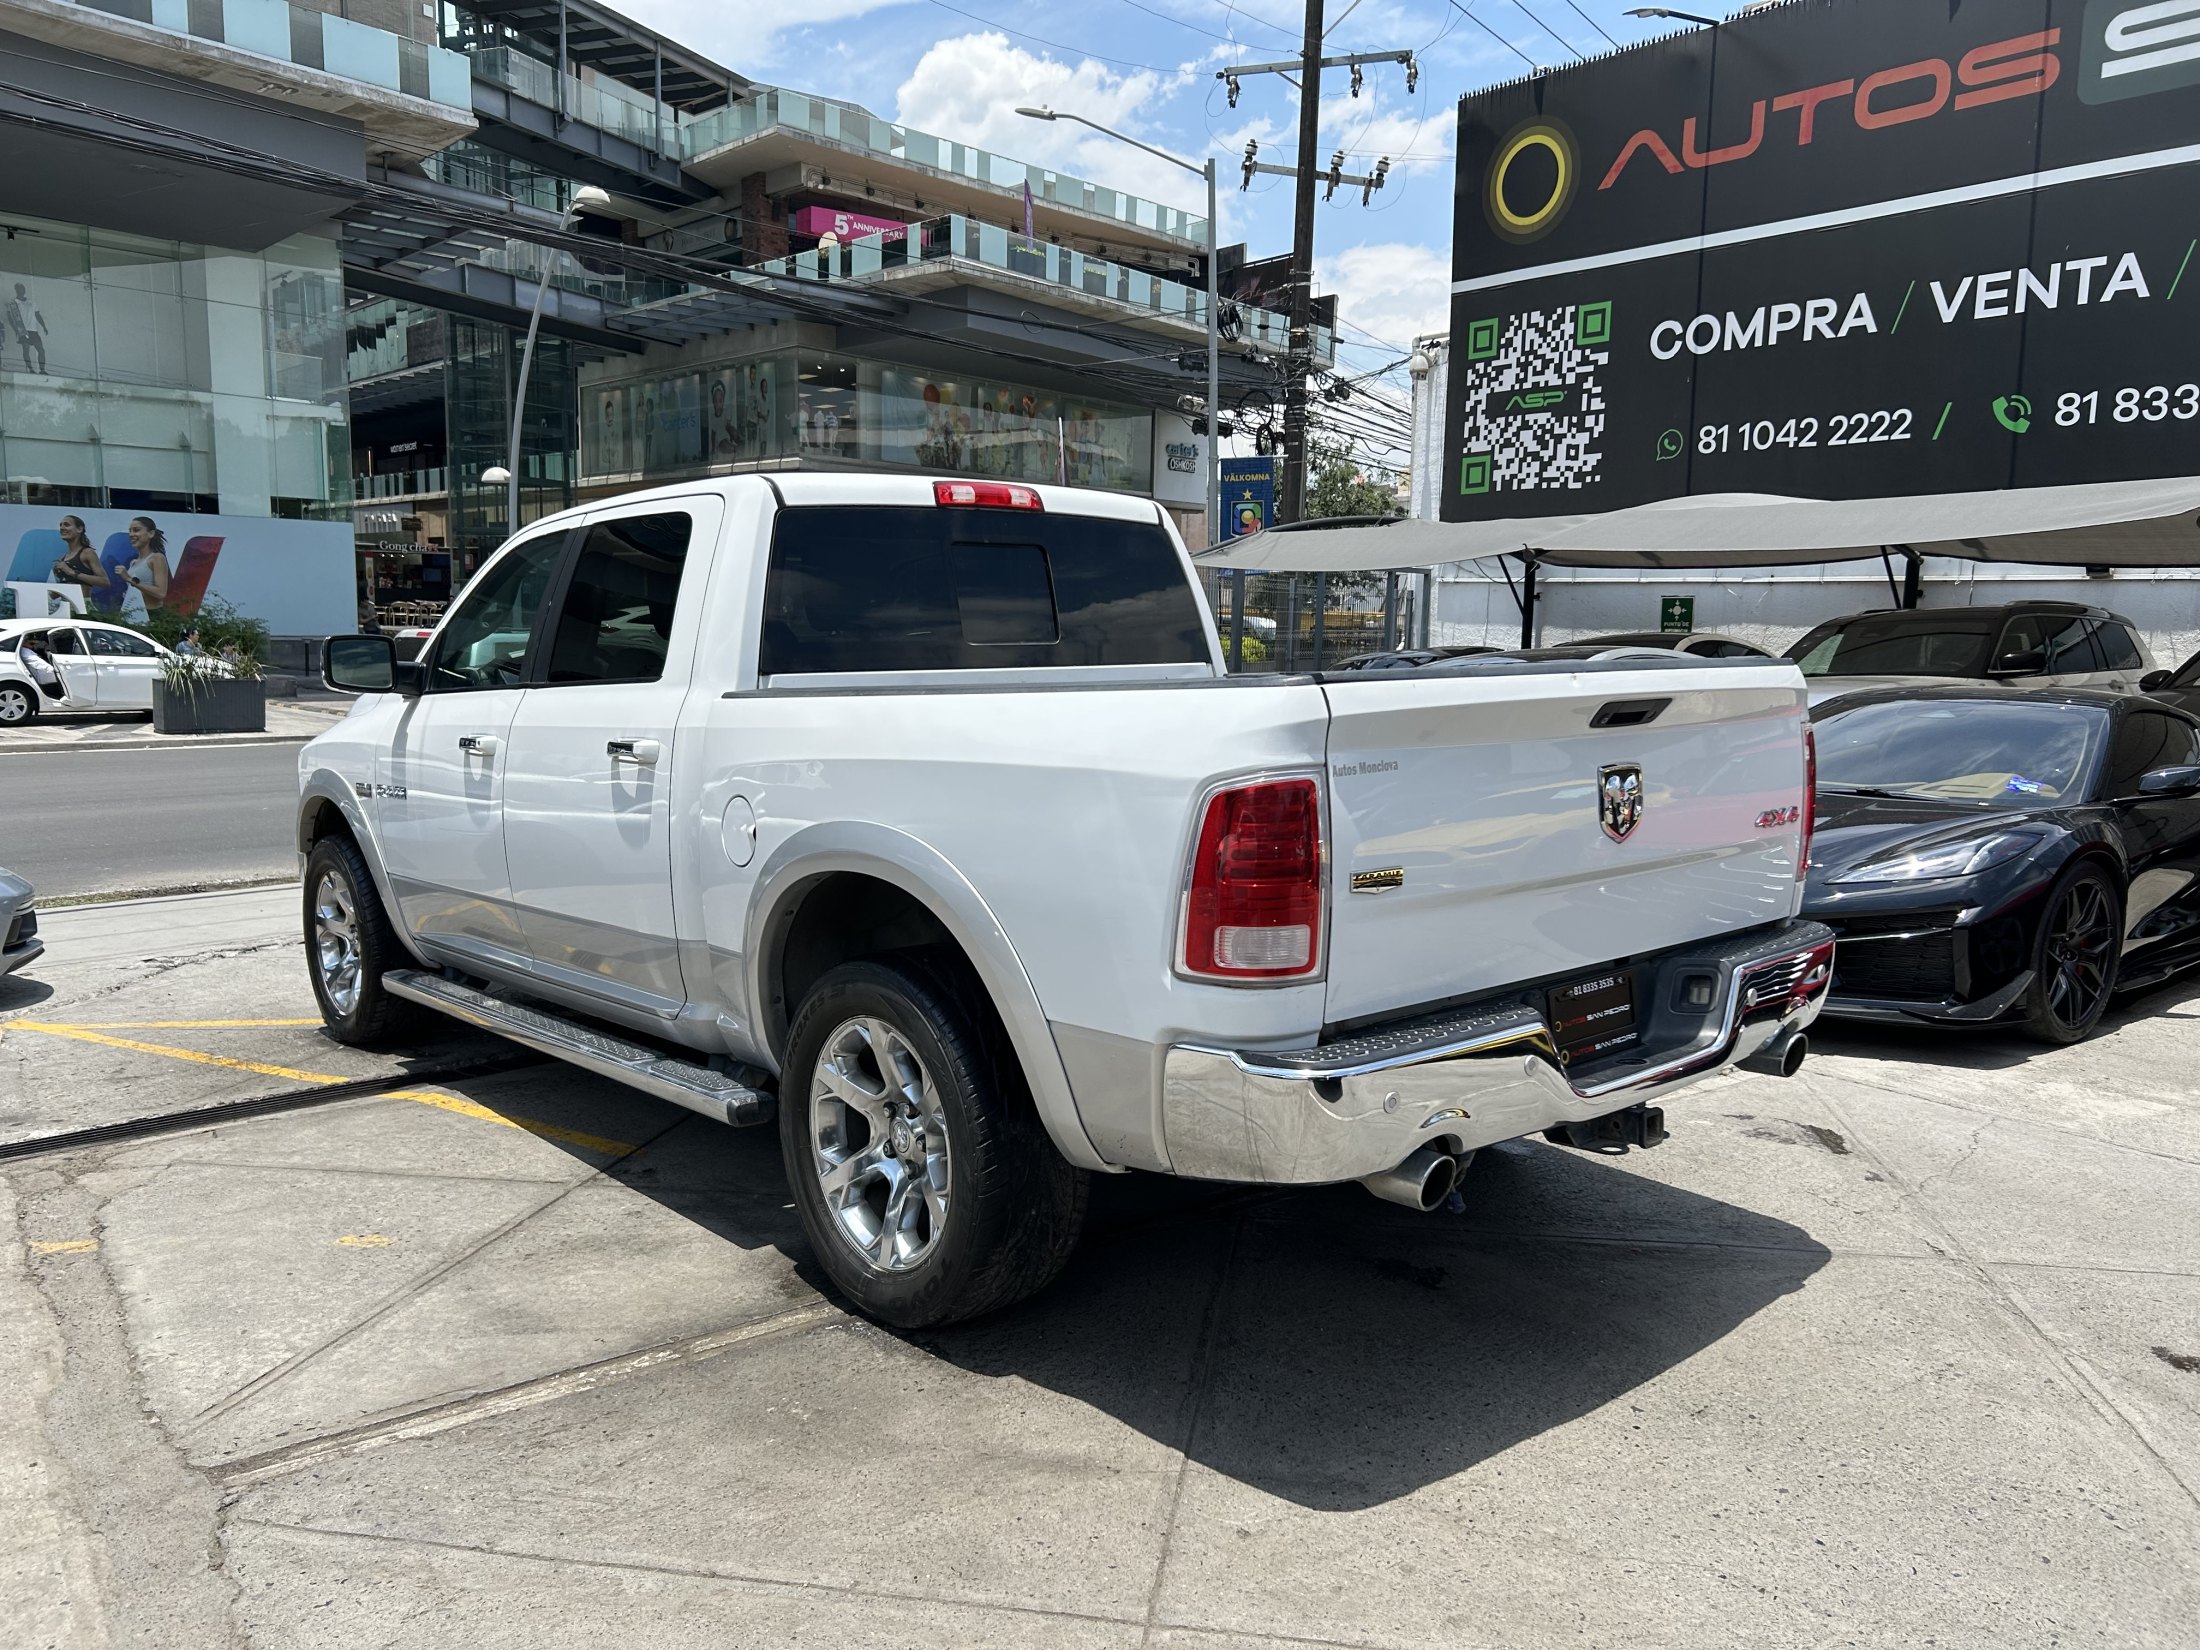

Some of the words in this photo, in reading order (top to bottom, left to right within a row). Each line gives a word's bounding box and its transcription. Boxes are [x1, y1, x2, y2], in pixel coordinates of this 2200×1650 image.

[1598, 27, 2061, 191] AUTOS
[1649, 292, 1878, 361] COMPRA
[1929, 252, 2150, 324] VENTA
[1505, 390, 1564, 411] ASP
[1697, 425, 1730, 455] 81
[1738, 417, 1818, 452] 1042
[1828, 408, 1913, 447] 2222
[2054, 391, 2099, 426] 81
[2112, 384, 2200, 423] 833
[380, 541, 408, 553] Gong
[1332, 764, 1357, 778] Autos
[1359, 760, 1399, 775] Monclova
[1573, 986, 1582, 996] 81
[1582, 981, 1598, 994] 8335
[1598, 977, 1614, 989] 3535
